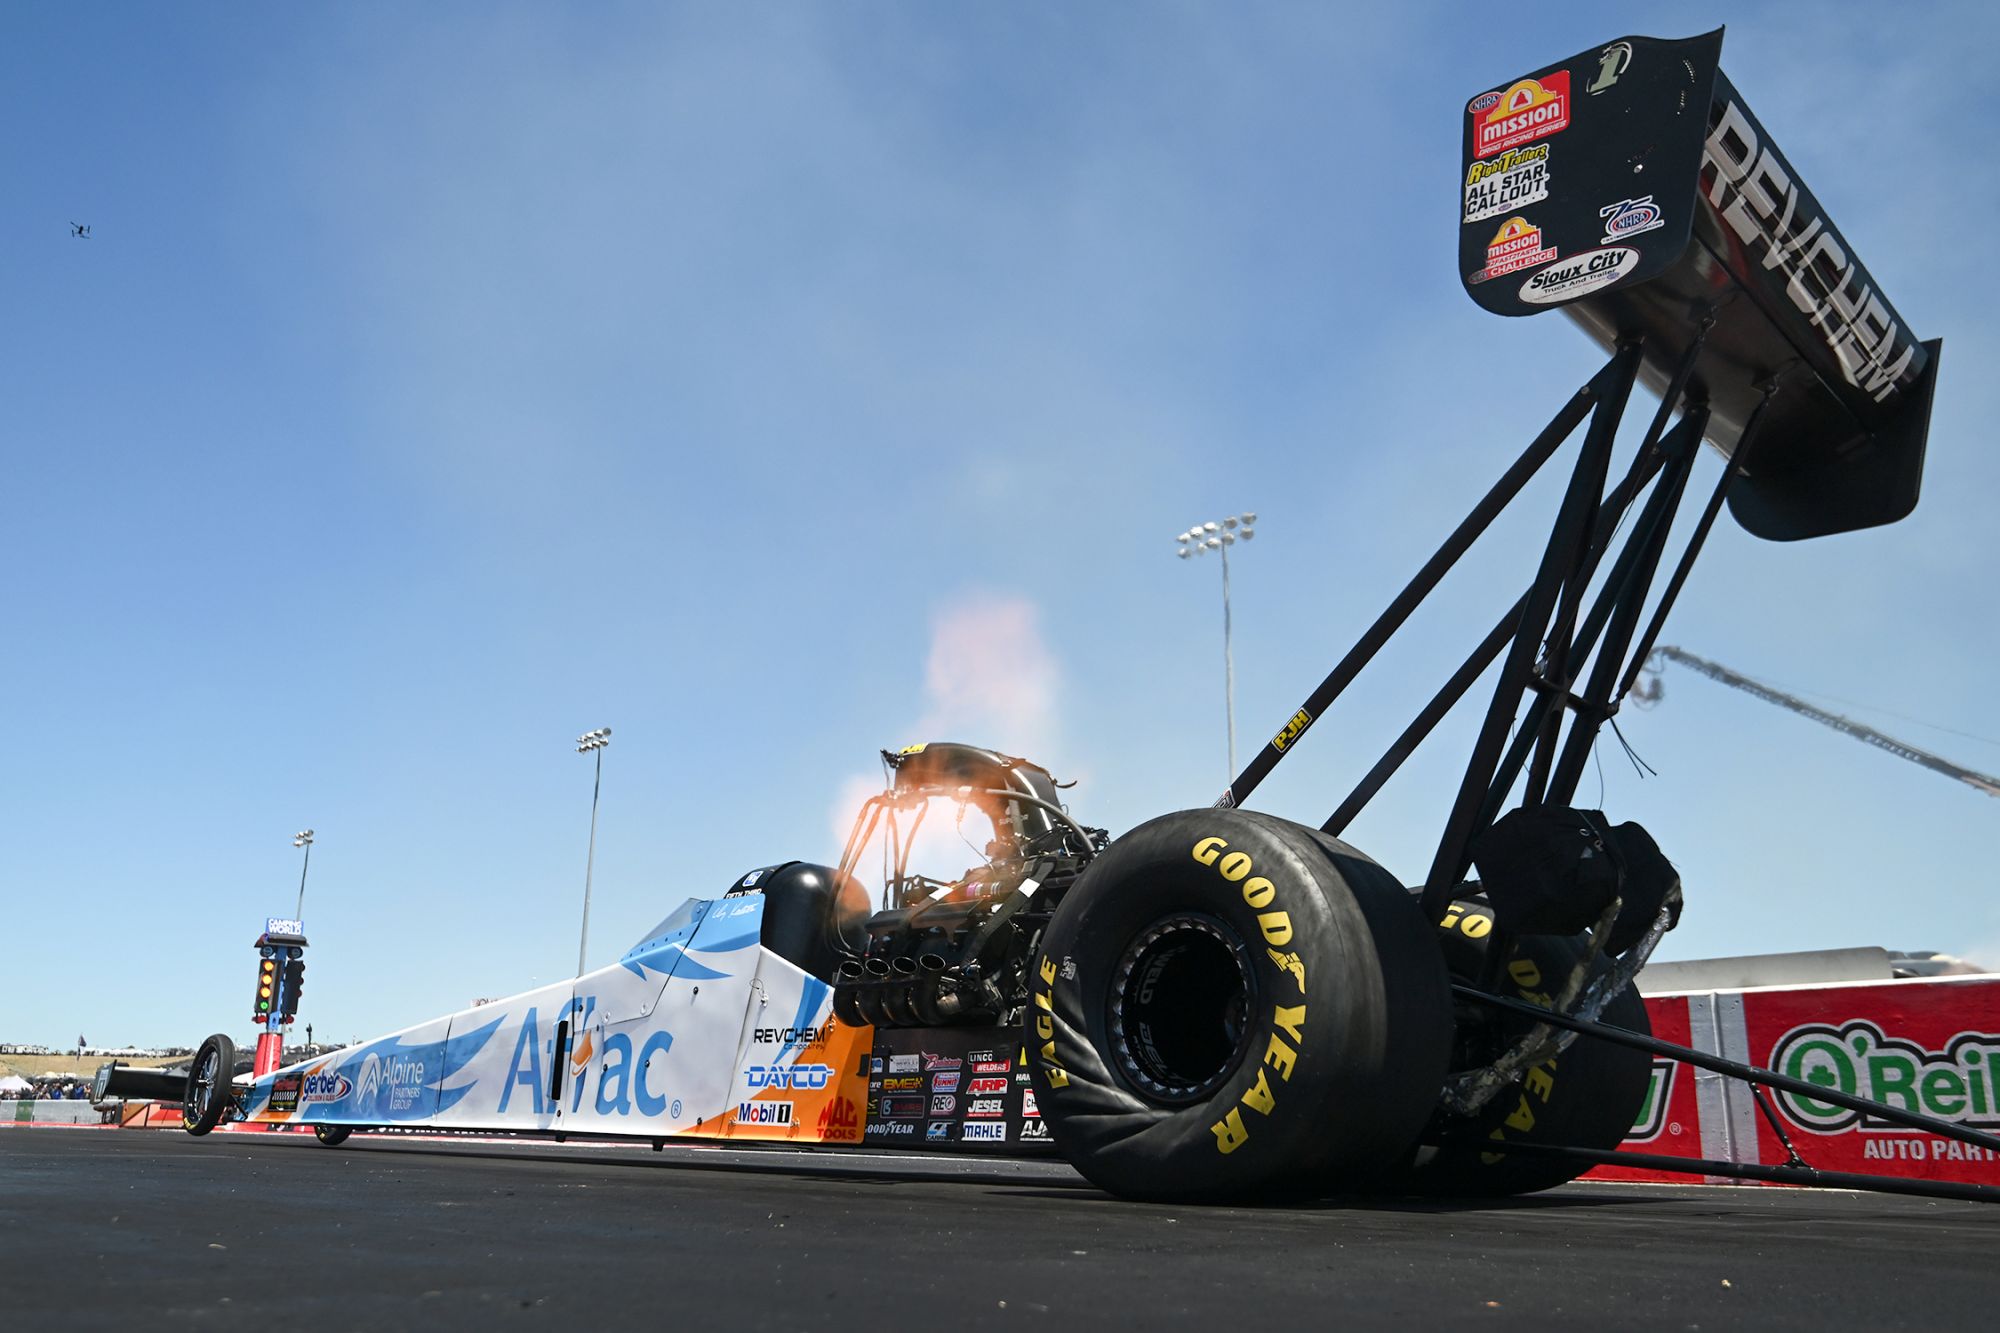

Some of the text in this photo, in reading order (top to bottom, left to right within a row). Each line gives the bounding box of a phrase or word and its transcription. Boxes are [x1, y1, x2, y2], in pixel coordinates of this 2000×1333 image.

[1473, 94, 1499, 110] NHRA
[1483, 102, 1560, 142] MISSION
[1478, 120, 1567, 156] DRAG RACING SERIES
[1467, 180, 1497, 202] ALL
[1501, 164, 1545, 190] STAR
[1466, 178, 1544, 216] CALLOUT
[1617, 212, 1646, 229] NHRA
[1487, 233, 1538, 258] MISSION
[1701, 99, 1915, 403] REVCHEM
[1490, 248, 1554, 276] CHALLENGE
[1530, 263, 1584, 290] Sioux
[1588, 250, 1628, 271] City
[1543, 284, 1566, 295] Truck
[1569, 275, 1587, 286] And
[1590, 268, 1617, 281] Trailer
[268, 925, 302, 935] WORLD
[1035, 954, 1070, 1090] EAGLE
[753, 1027, 826, 1043] REVCHEM
[497, 996, 674, 1117] Aflac
[976, 1063, 1007, 1071] WELDERS
[303, 1069, 340, 1101] gerber
[381, 1056, 424, 1104] Alpine
[746, 1066, 830, 1087] DAYCO
[968, 1079, 1007, 1093] ARP
[393, 1099, 412, 1110] GROUP
[738, 1103, 777, 1123] Mobil
[817, 1096, 858, 1127] MAC
[967, 1099, 1005, 1113] JESEL
[817, 1128, 857, 1140] TOOLS
[964, 1125, 1002, 1138] MAHLE
[1864, 1139, 1926, 1160] AUTO
